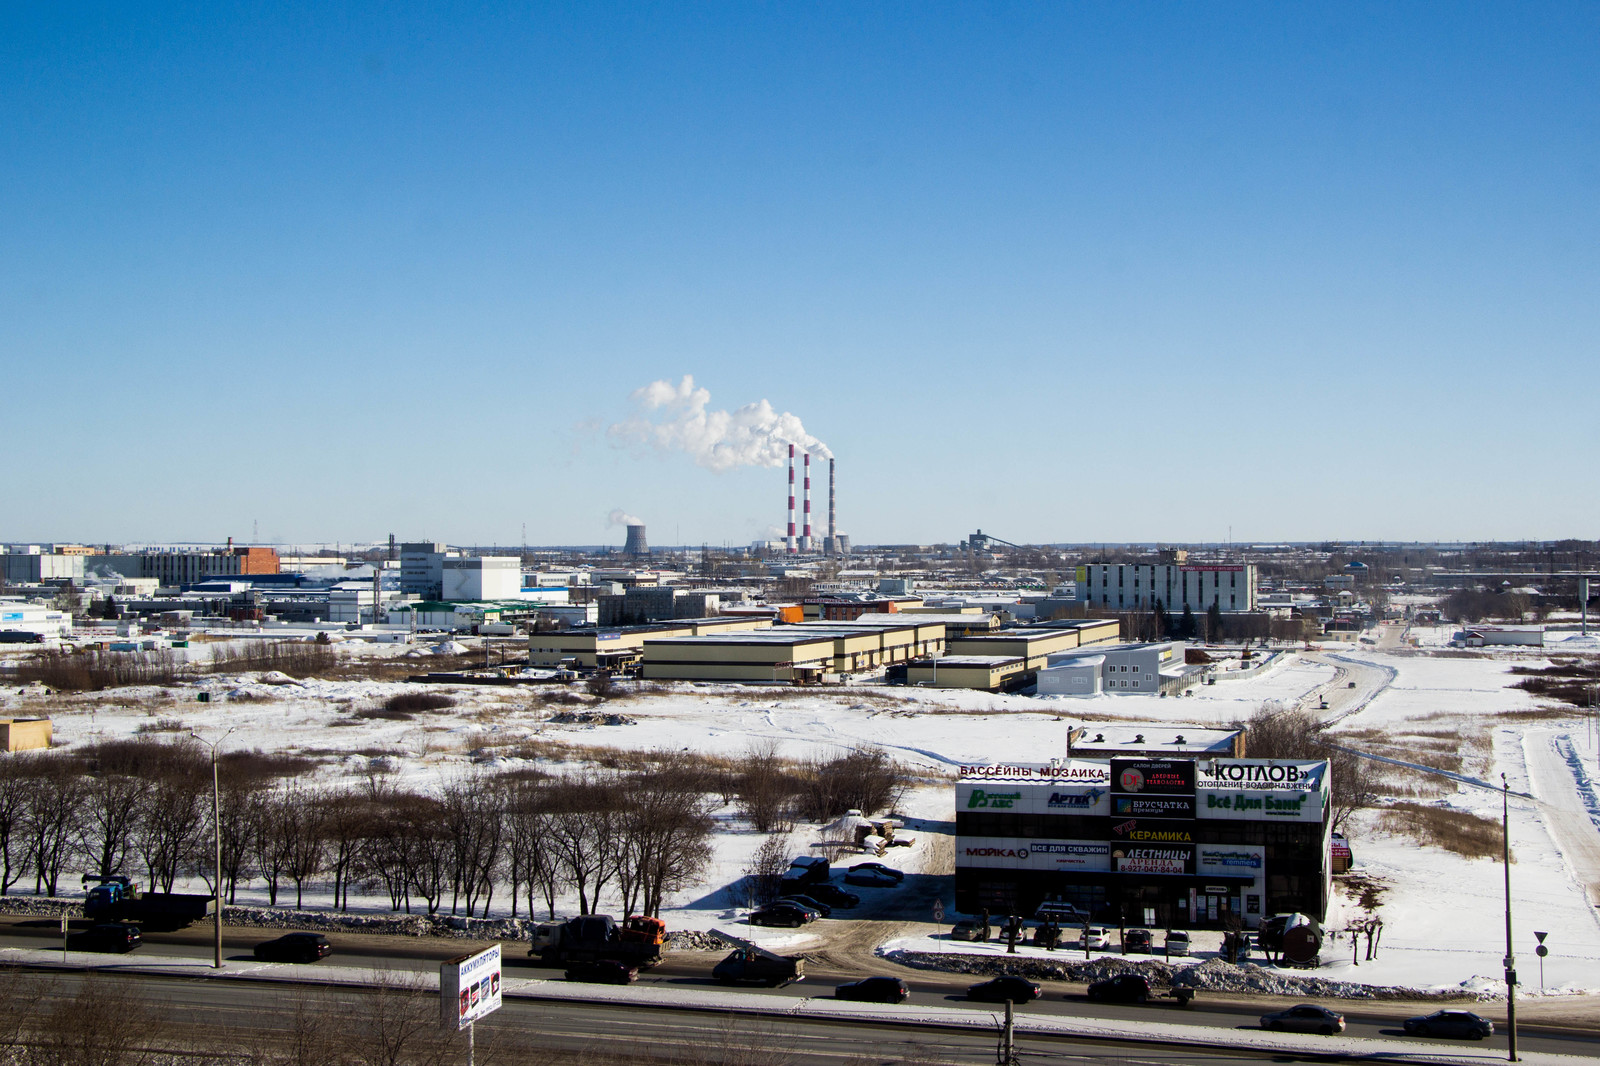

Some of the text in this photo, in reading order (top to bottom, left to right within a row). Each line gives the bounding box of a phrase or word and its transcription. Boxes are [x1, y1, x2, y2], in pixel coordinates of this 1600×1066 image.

[960, 764, 1105, 778] БАССЕЙНЫ МОЗАИКА
[1204, 764, 1309, 782] «КОТЛОВ»
[1133, 801, 1189, 809] БРУСЧАТКА
[1234, 794, 1262, 811] Для
[1265, 795, 1301, 811] Бани
[1113, 819, 1136, 835] VIP
[1130, 831, 1191, 841] КЕРАМИКА
[966, 847, 1017, 857] МОЙКА
[1049, 845, 1065, 853] ДЛЯ
[1127, 849, 1191, 860] ЛЕСТНИЦЫ
[1129, 858, 1173, 867] АРЕНДА
[1121, 865, 1182, 873] 8-927-047-84-04
[461, 947, 499, 976] АККУМУЛЯТОРЫ
